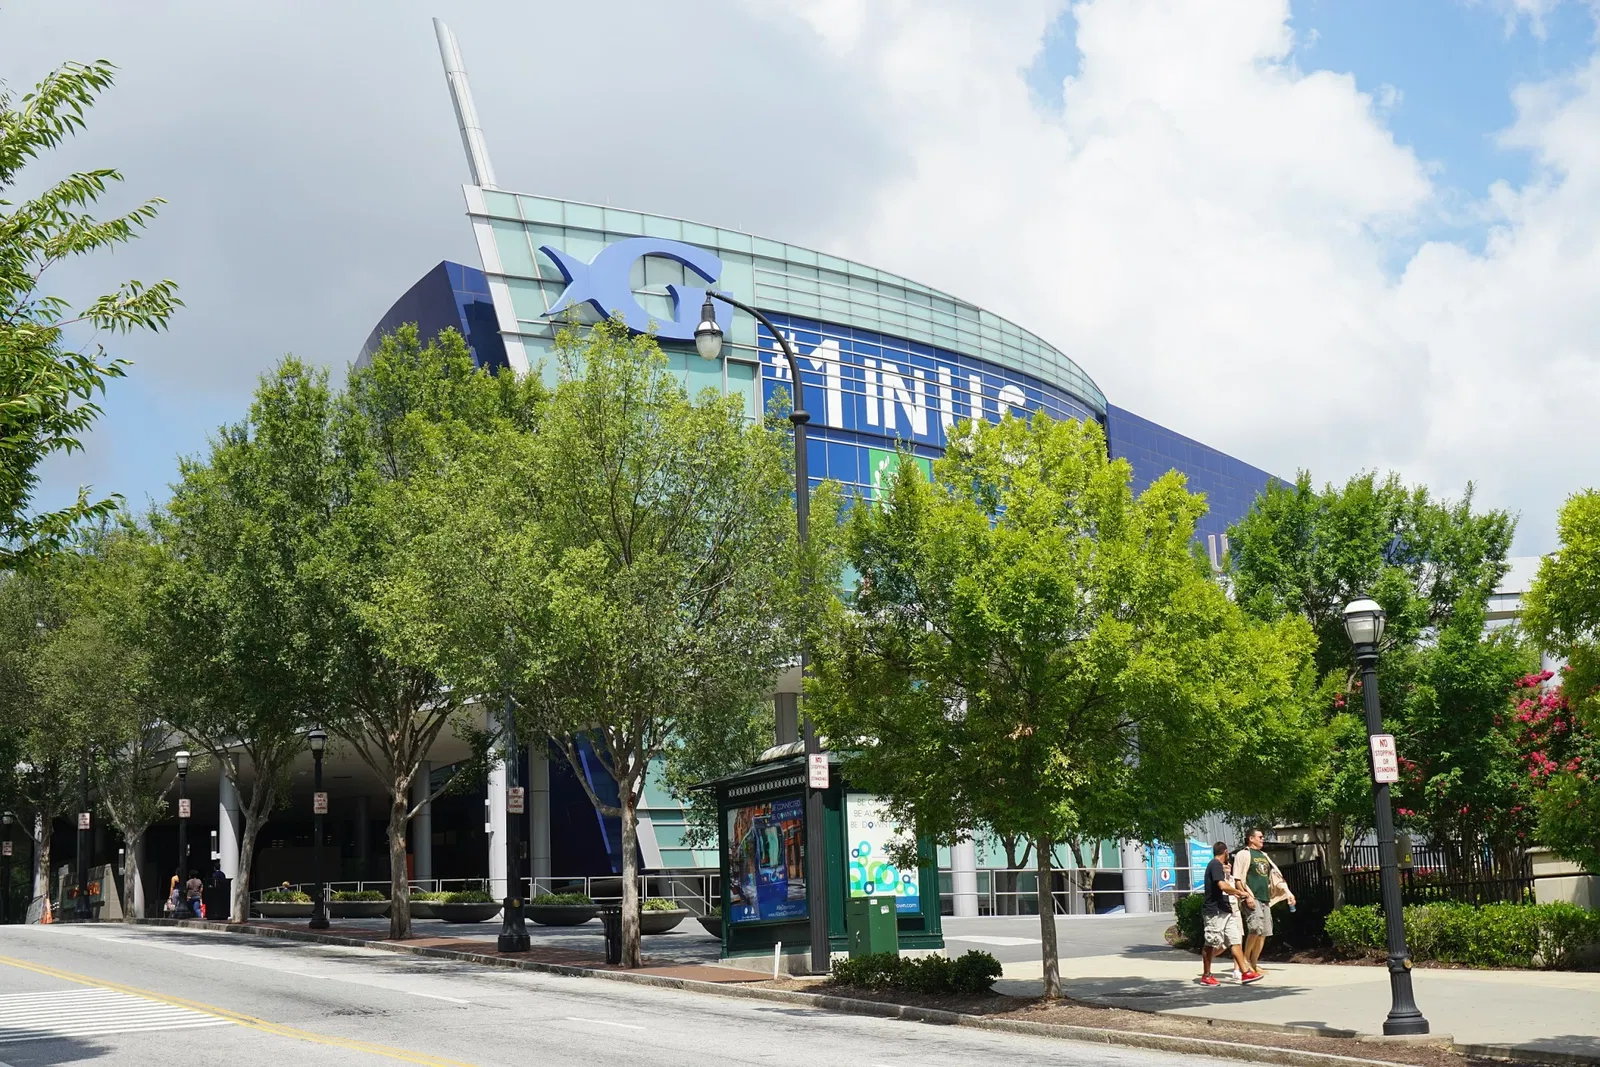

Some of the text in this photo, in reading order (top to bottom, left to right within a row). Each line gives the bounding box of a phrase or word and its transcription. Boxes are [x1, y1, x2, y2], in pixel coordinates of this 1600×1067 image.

[1379, 739, 1388, 747] NO
[858, 798, 866, 806] BE
[854, 809, 862, 817] BE
[851, 821, 897, 829] BE DOWNTO
